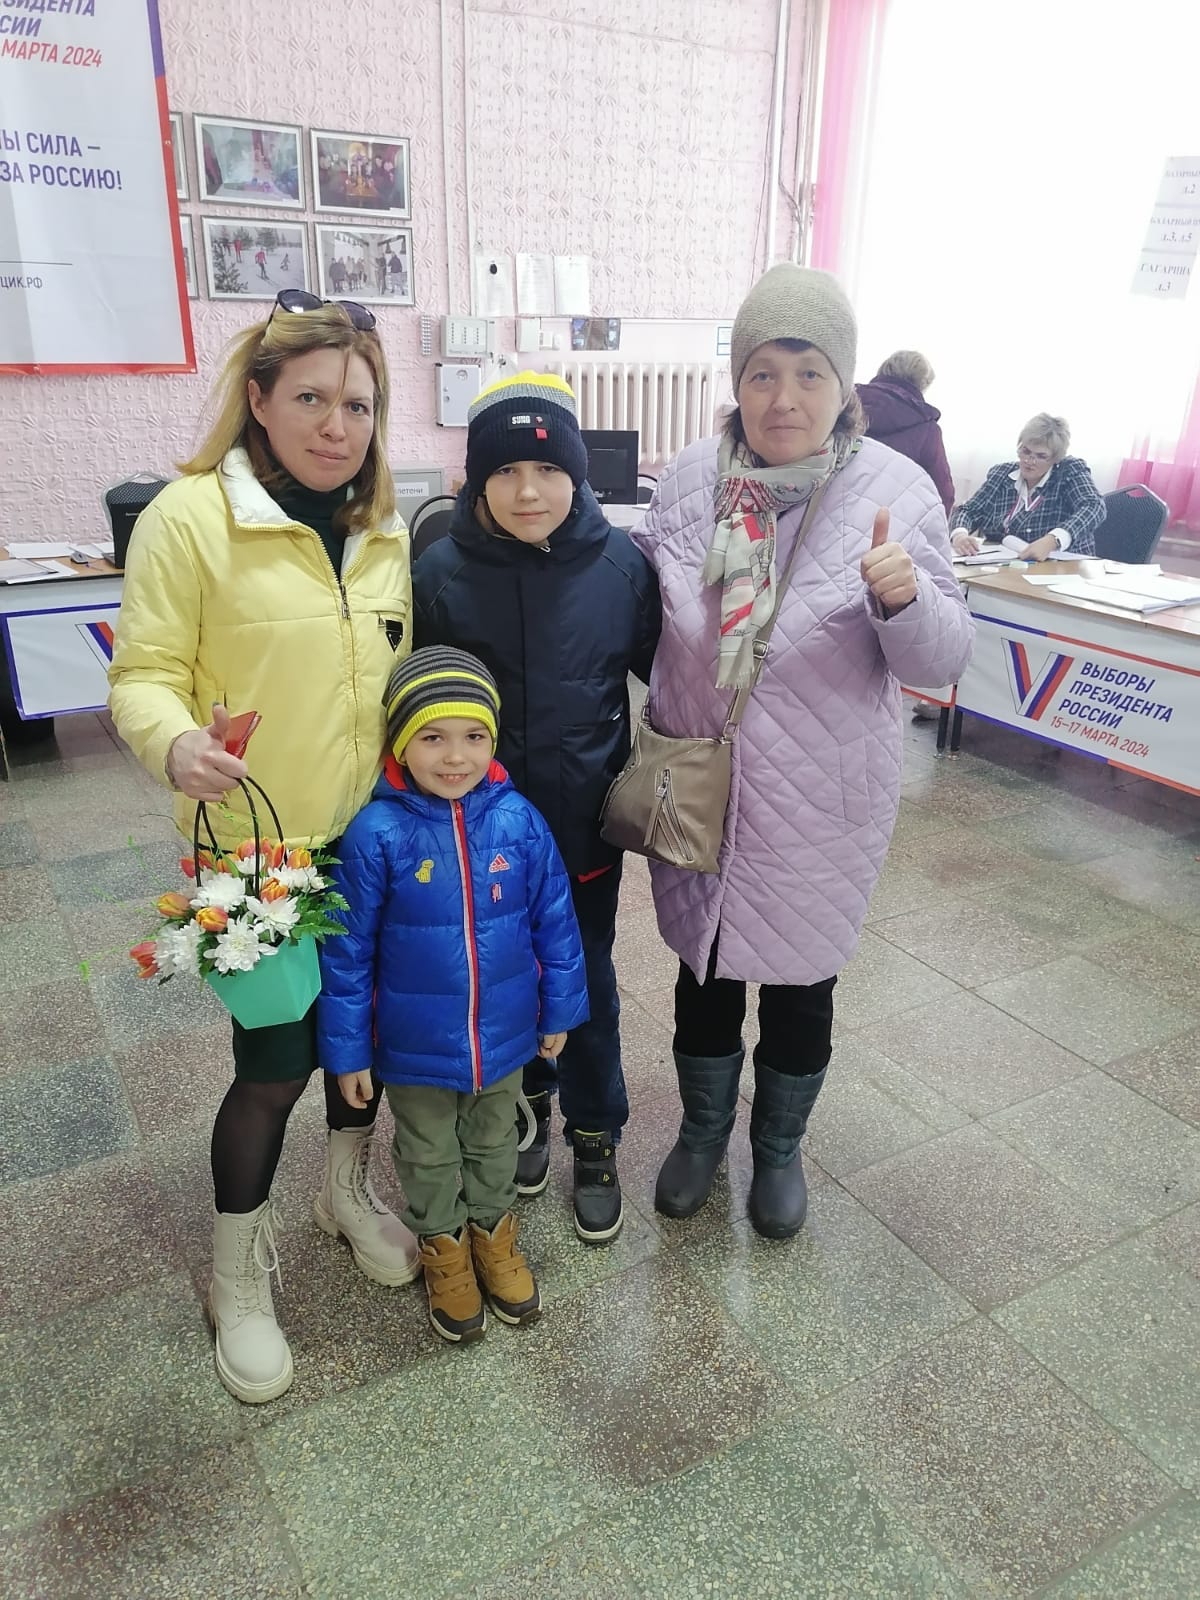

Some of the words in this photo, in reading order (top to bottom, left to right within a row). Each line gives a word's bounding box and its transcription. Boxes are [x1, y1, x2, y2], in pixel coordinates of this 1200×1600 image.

[1, 38, 58, 63] МАРТА
[62, 45, 102, 67] 2024
[0, 129, 20, 151] Ы
[27, 132, 82, 157] СИЛА
[0, 160, 24, 183] ЗА
[28, 163, 122, 190] РОССИЮ!
[1080, 662, 1155, 694] ВЫБОРЫ
[1058, 699, 1124, 729] РОССИИ
[1069, 680, 1174, 723] ПРЕЗИДЕНТА
[1080, 725, 1120, 748] МАРТА
[1119, 738, 1149, 757] 2024
